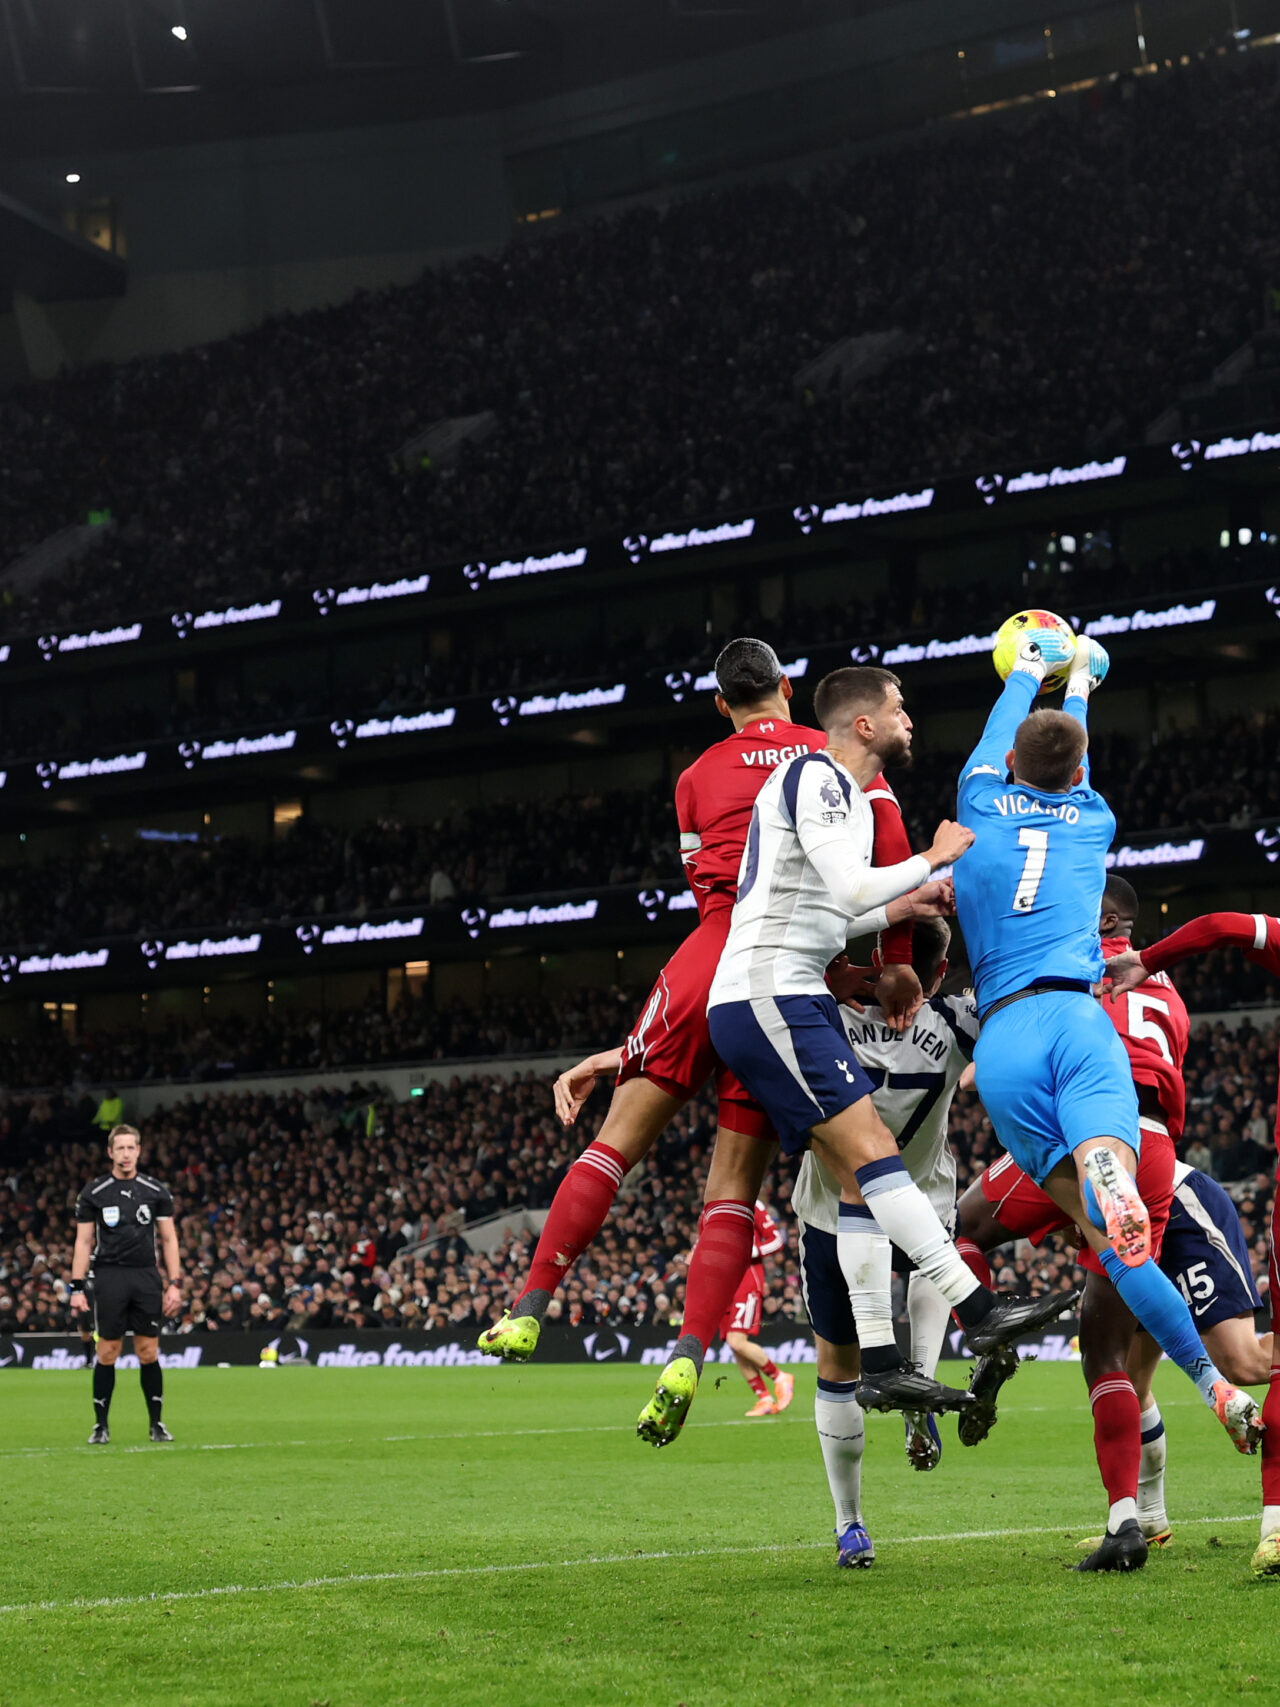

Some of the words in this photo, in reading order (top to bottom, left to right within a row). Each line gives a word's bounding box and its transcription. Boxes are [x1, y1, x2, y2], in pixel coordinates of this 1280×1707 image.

[1204, 438, 1250, 459] nike
[1006, 472, 1048, 493] nike
[1048, 456, 1126, 486] football
[822, 503, 861, 522] nike
[861, 489, 934, 516] football
[650, 533, 686, 552] nike
[686, 519, 754, 546] football
[488, 561, 523, 579] nike
[523, 548, 587, 574] football
[337, 587, 369, 605] nike
[369, 575, 429, 599] football
[194, 611, 224, 628] nike
[224, 600, 281, 623] football
[1083, 615, 1130, 640] nike
[1130, 600, 1215, 630] football
[59, 634, 87, 651] nike
[87, 624, 142, 646] football
[882, 643, 925, 666] nike
[519, 696, 557, 715] nike
[557, 684, 625, 710] football
[356, 719, 390, 738] nike
[390, 708, 455, 733] football
[202, 741, 235, 759] nike
[235, 731, 296, 754] football
[58, 762, 89, 779] nike
[89, 752, 146, 775] football
[1117, 839, 1205, 868] football
[1012, 827, 1049, 912] 1
[489, 909, 529, 928] nike
[529, 900, 598, 924] football
[322, 926, 358, 944] nike
[358, 918, 424, 940] football
[19, 956, 50, 973] nike
[50, 949, 109, 970] football
[165, 941, 199, 959] nike
[199, 934, 261, 956] football
[849, 1023, 877, 1046] AN
[911, 1025, 949, 1062] VEN
[1127, 991, 1175, 1067] 5
[1176, 1261, 1215, 1306] 15
[317, 1344, 381, 1367] nike
